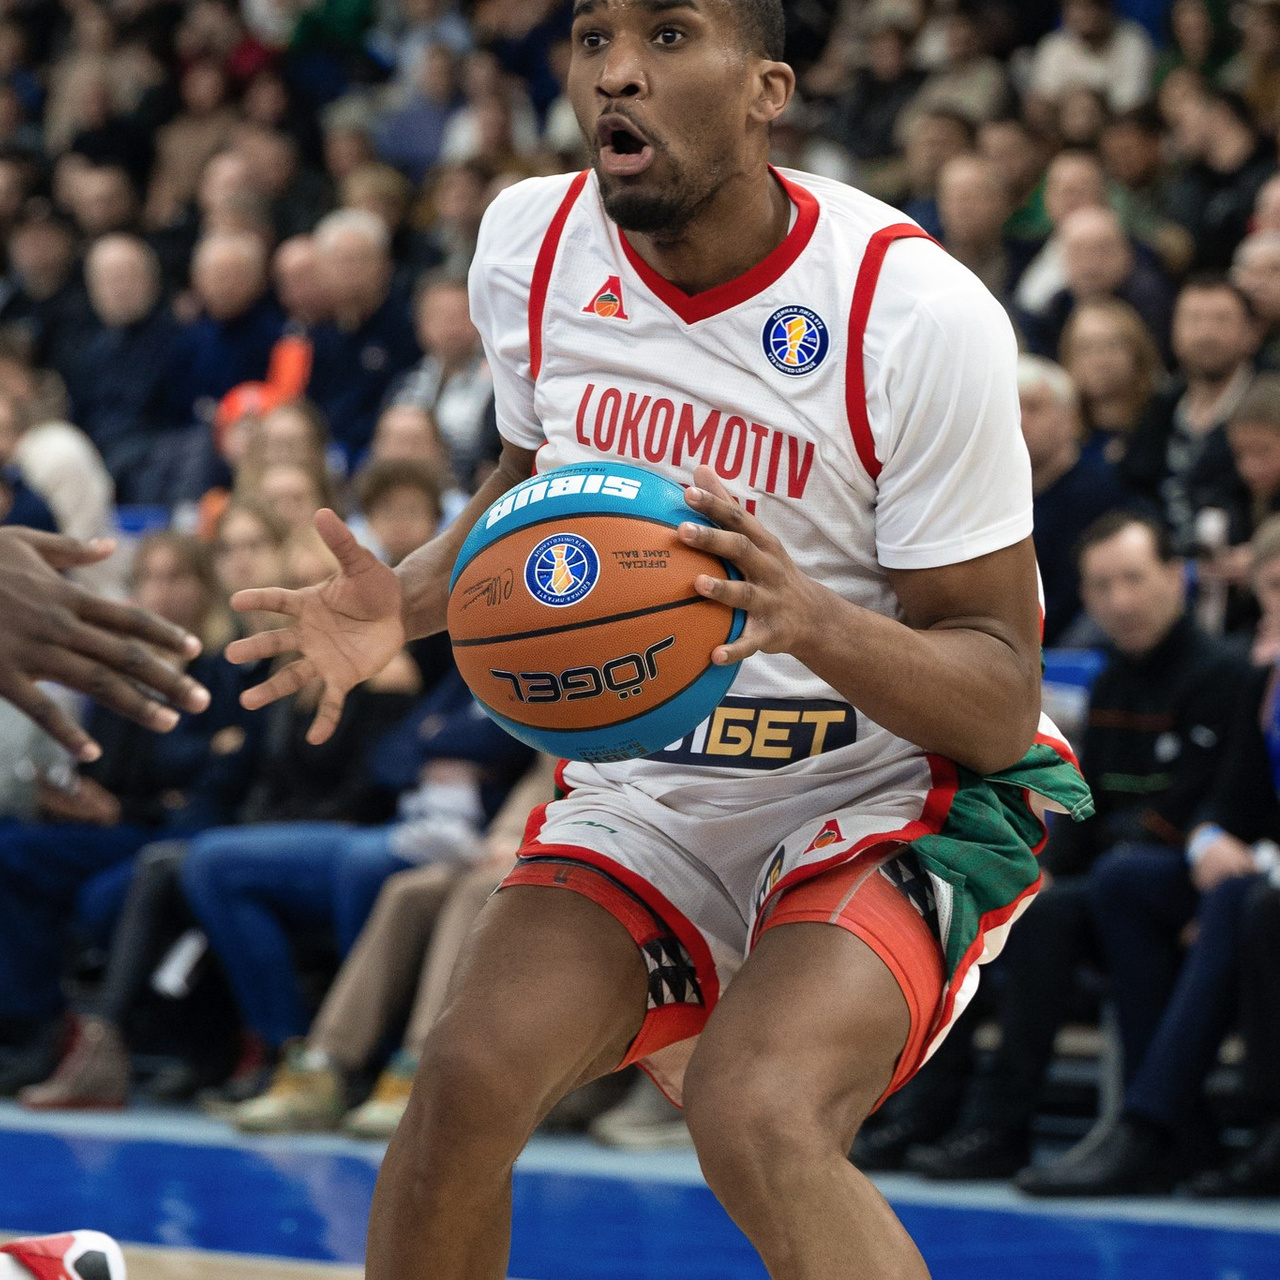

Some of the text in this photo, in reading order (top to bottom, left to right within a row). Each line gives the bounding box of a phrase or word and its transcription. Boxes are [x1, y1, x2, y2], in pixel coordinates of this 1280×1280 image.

[575, 383, 816, 499] LOKOMOTIV
[485, 474, 642, 530] SIBUR
[612, 550, 671, 559] GAME BALL
[619, 560, 667, 569] OFFICIAL
[490, 634, 675, 703] JÖGEL
